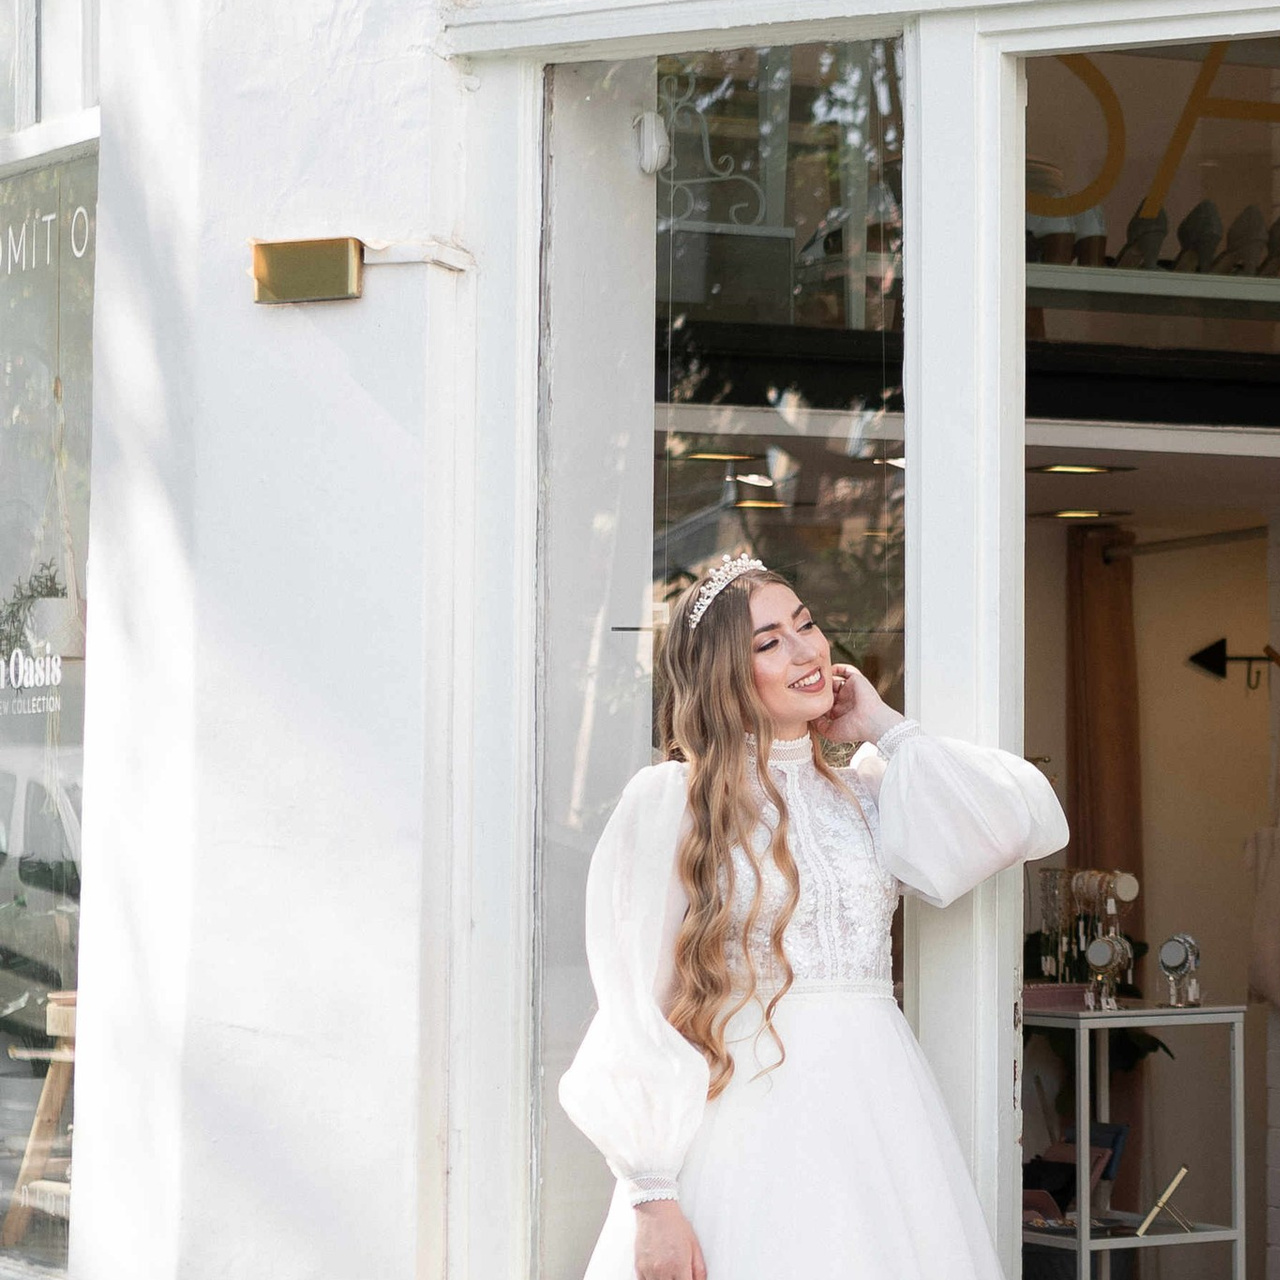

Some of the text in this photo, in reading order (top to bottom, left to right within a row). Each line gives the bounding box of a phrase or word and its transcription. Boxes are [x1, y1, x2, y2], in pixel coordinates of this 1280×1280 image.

[0, 212, 57, 275] MIT
[9, 641, 62, 690] Oasis
[11, 694, 61, 715] COLLECTION
